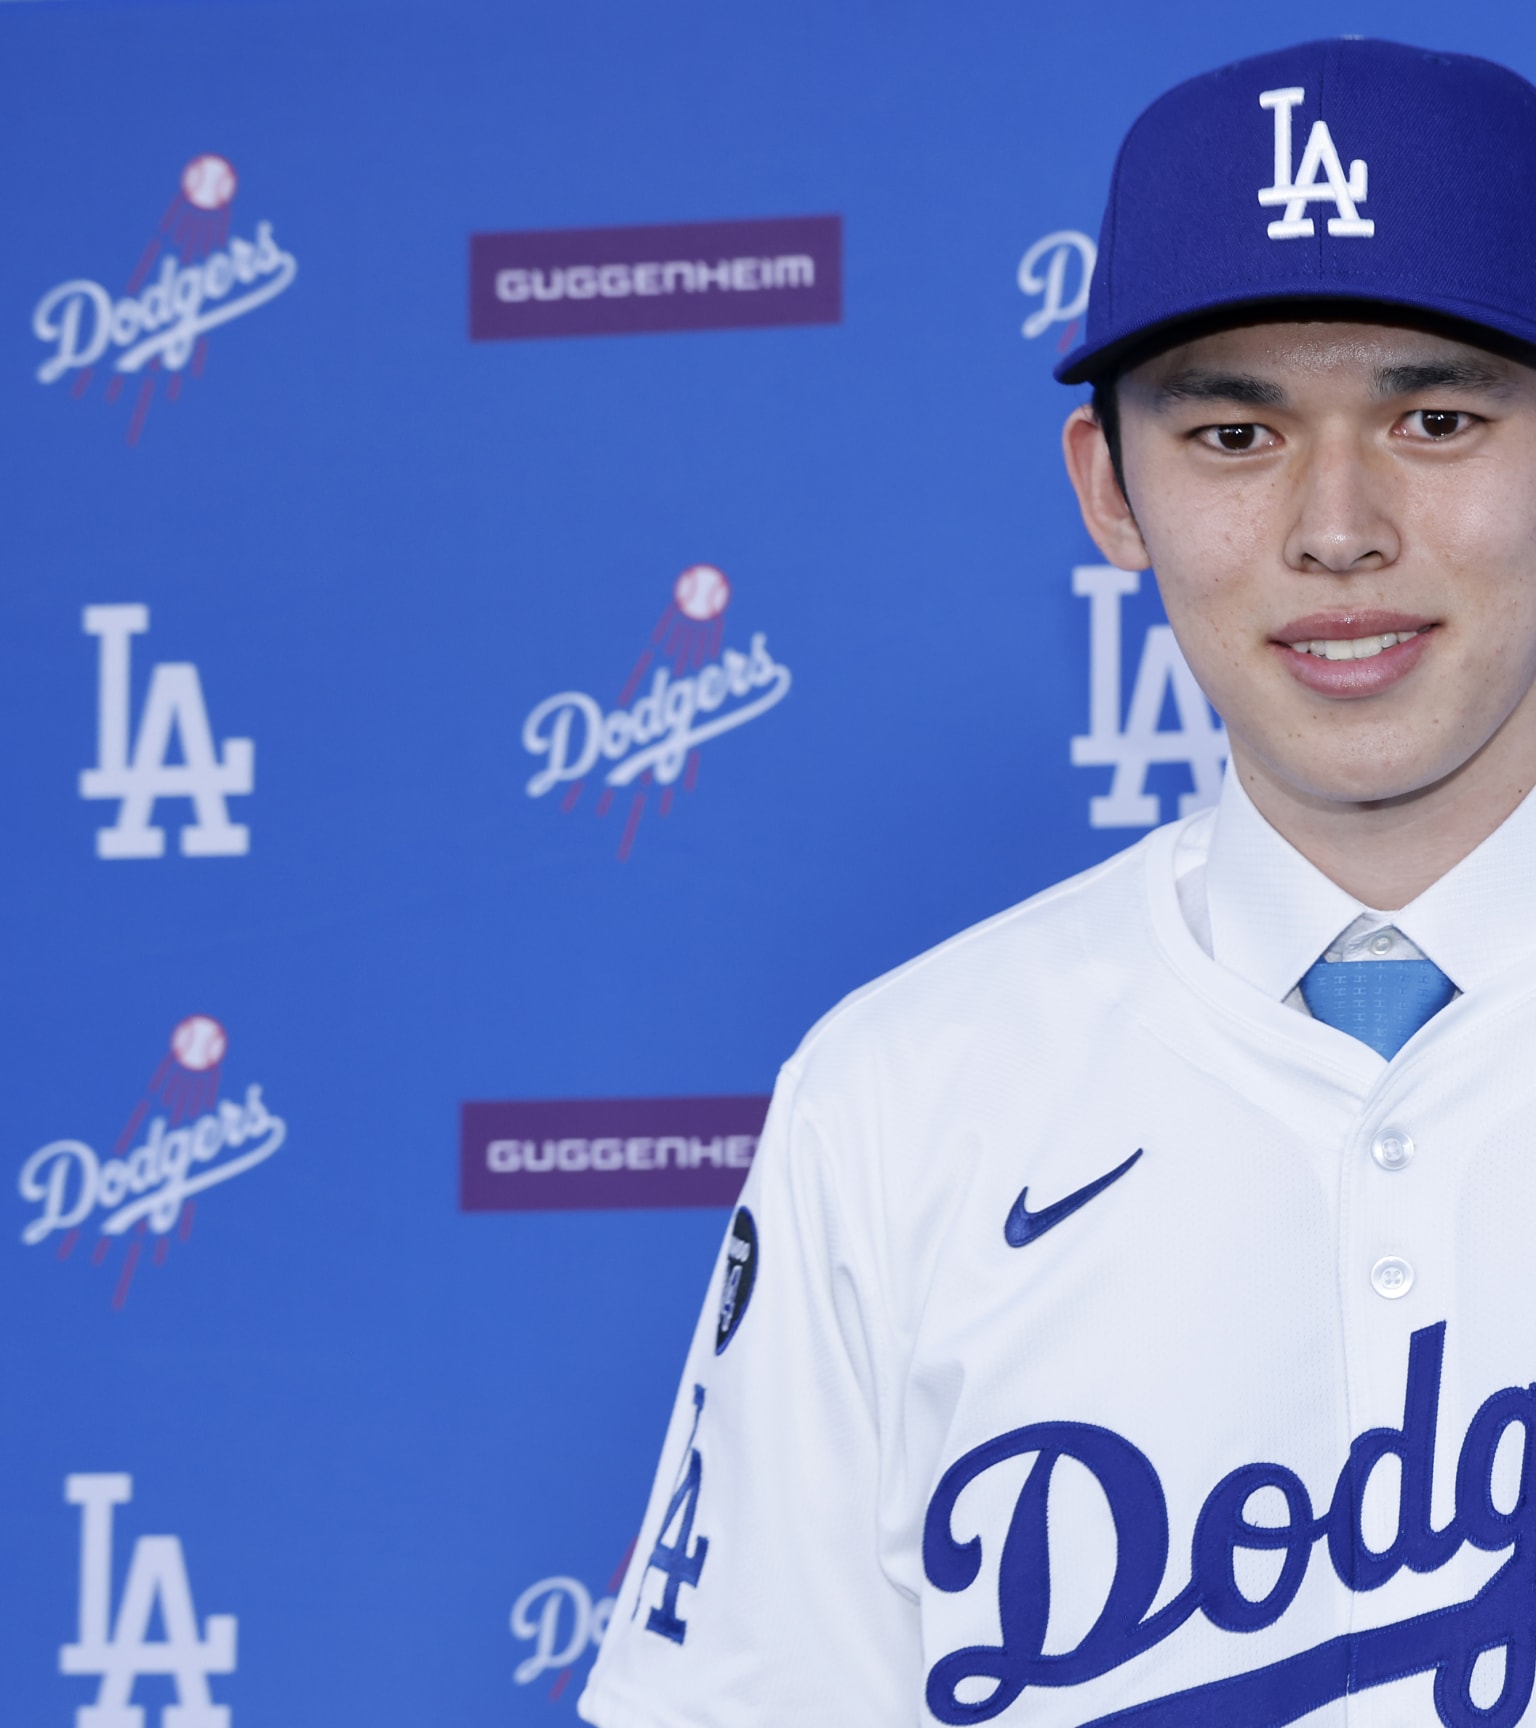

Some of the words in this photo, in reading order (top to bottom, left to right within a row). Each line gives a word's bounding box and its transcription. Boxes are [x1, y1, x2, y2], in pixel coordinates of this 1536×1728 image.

[1258, 87, 1375, 239] LA
[34, 222, 296, 384] Dodgers
[496, 254, 816, 303] GUGGENHEIM
[80, 603, 254, 859] LA
[522, 633, 792, 798] Dodgers
[19, 1085, 286, 1245] Dodgers
[487, 1134, 760, 1173] GUGGENHE
[631, 1383, 709, 1645] A
[60, 1473, 238, 1728] LA
